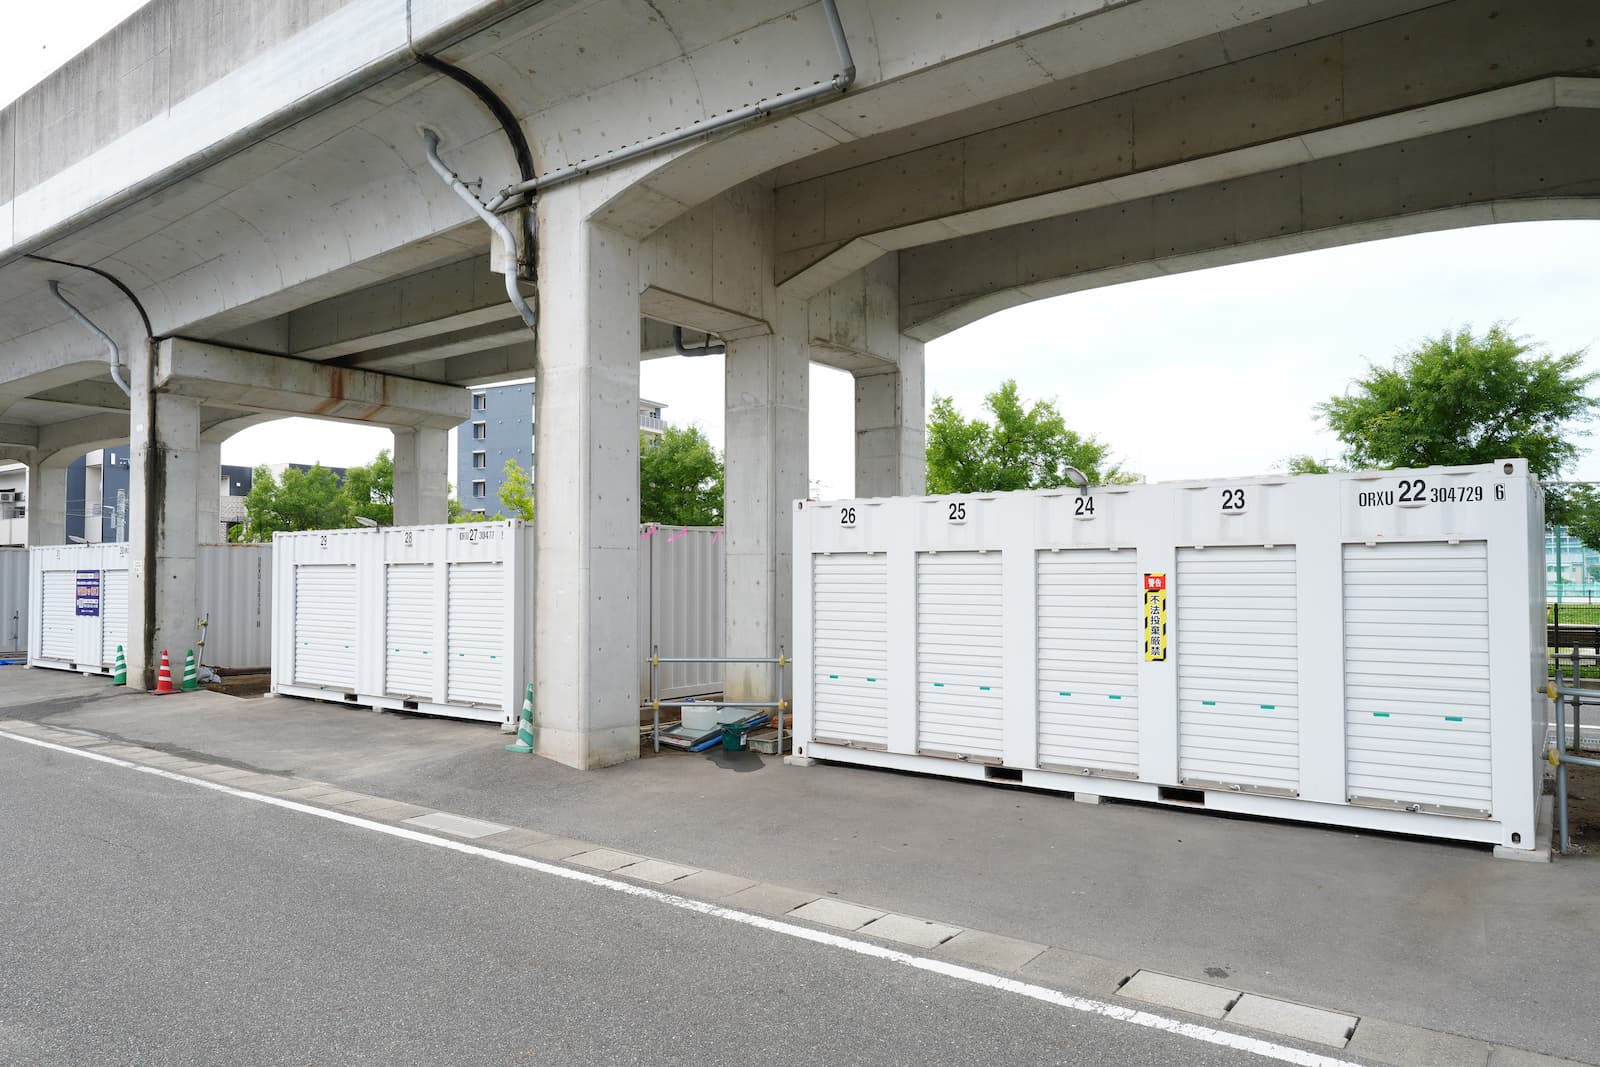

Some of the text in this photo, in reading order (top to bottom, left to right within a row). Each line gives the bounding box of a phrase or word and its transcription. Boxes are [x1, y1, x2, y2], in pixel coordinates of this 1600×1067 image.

[1222, 489, 1246, 510] 23
[1358, 480, 1505, 507] ORXU 22 304729 6
[949, 502, 966, 520] 25
[1074, 496, 1095, 516] 24
[841, 507, 856, 525] 26
[320, 535, 328, 547] 29
[405, 532, 413, 544] 28
[470, 529, 478, 541] 27
[1150, 595, 1161, 656] 不法投棄厳禁
